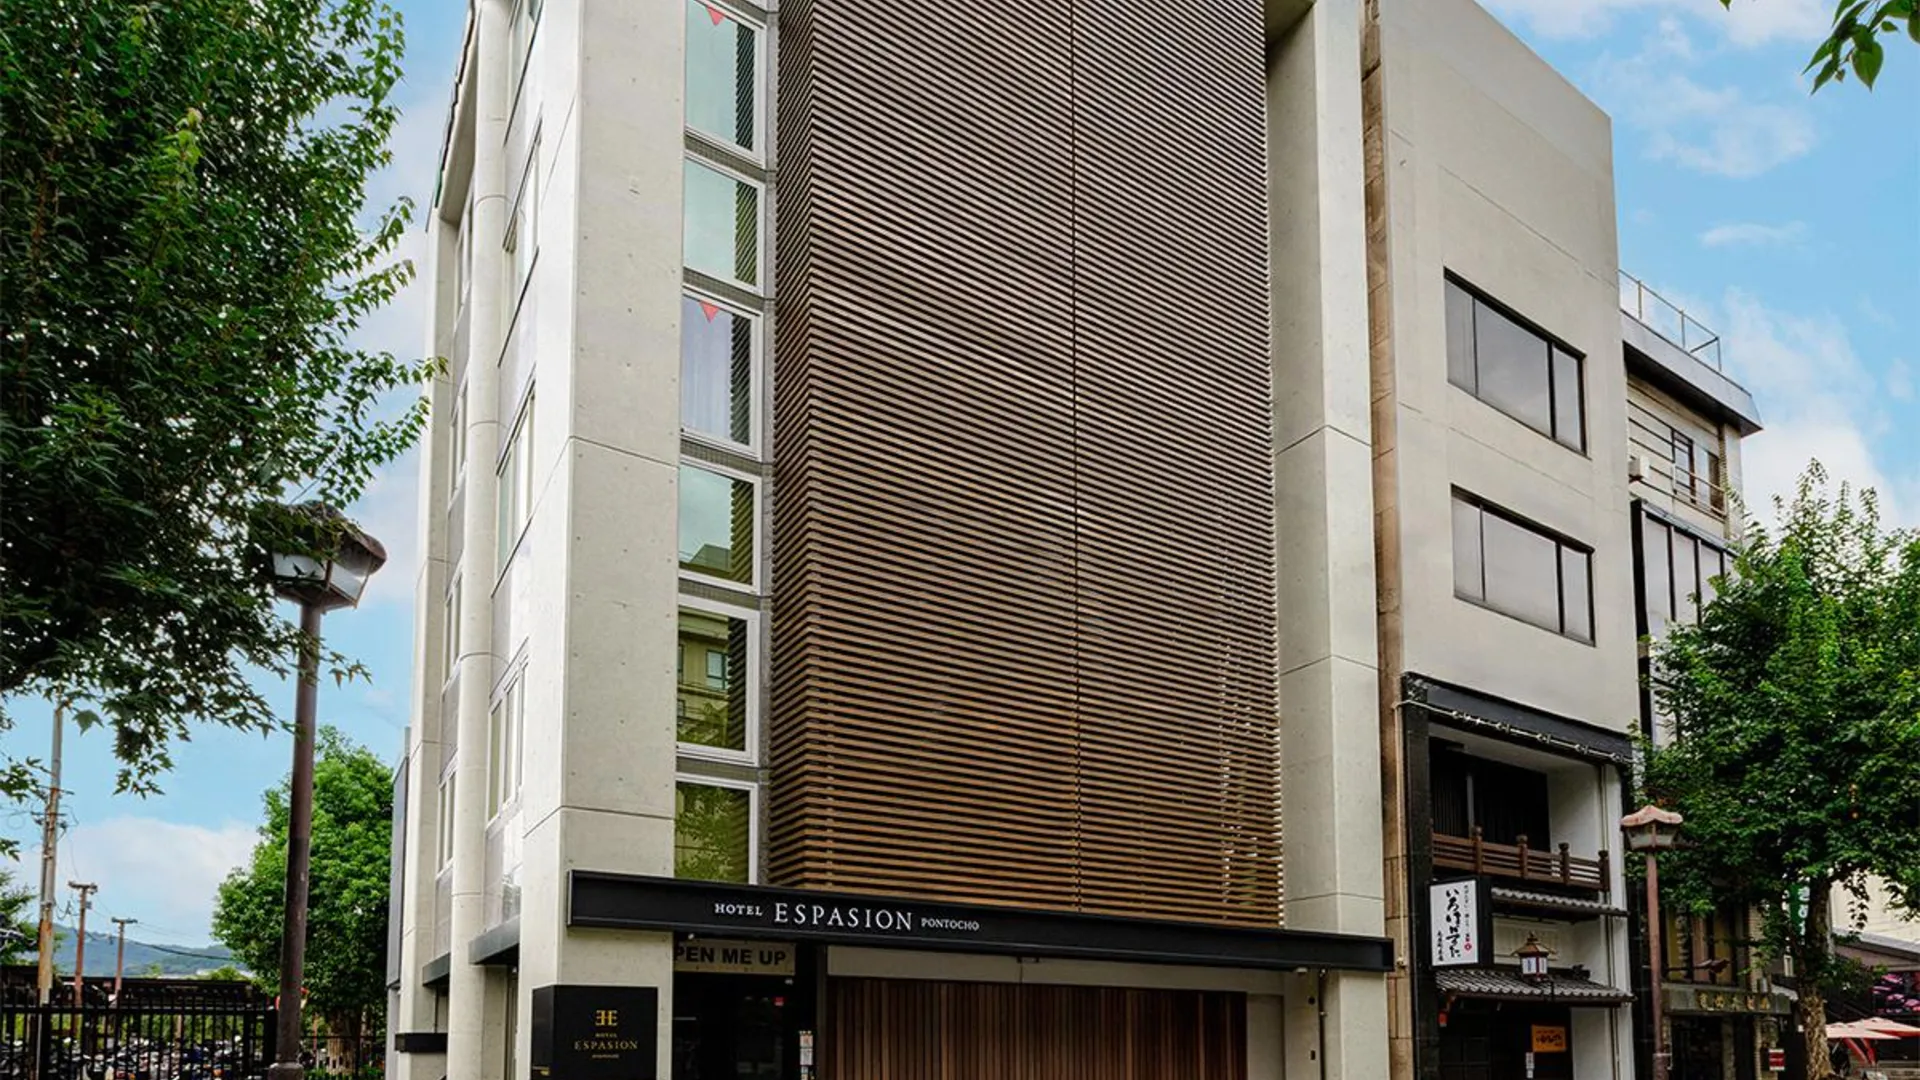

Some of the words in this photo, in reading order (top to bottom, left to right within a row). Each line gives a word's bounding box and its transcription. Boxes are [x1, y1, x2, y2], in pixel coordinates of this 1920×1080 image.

[714, 903, 763, 916] HOTEL
[774, 902, 912, 931] ESPASION
[921, 917, 980, 931] PONTOCHO
[722, 948, 752, 965] ME
[760, 950, 786, 966] UP
[574, 1040, 638, 1050] ESPASION
